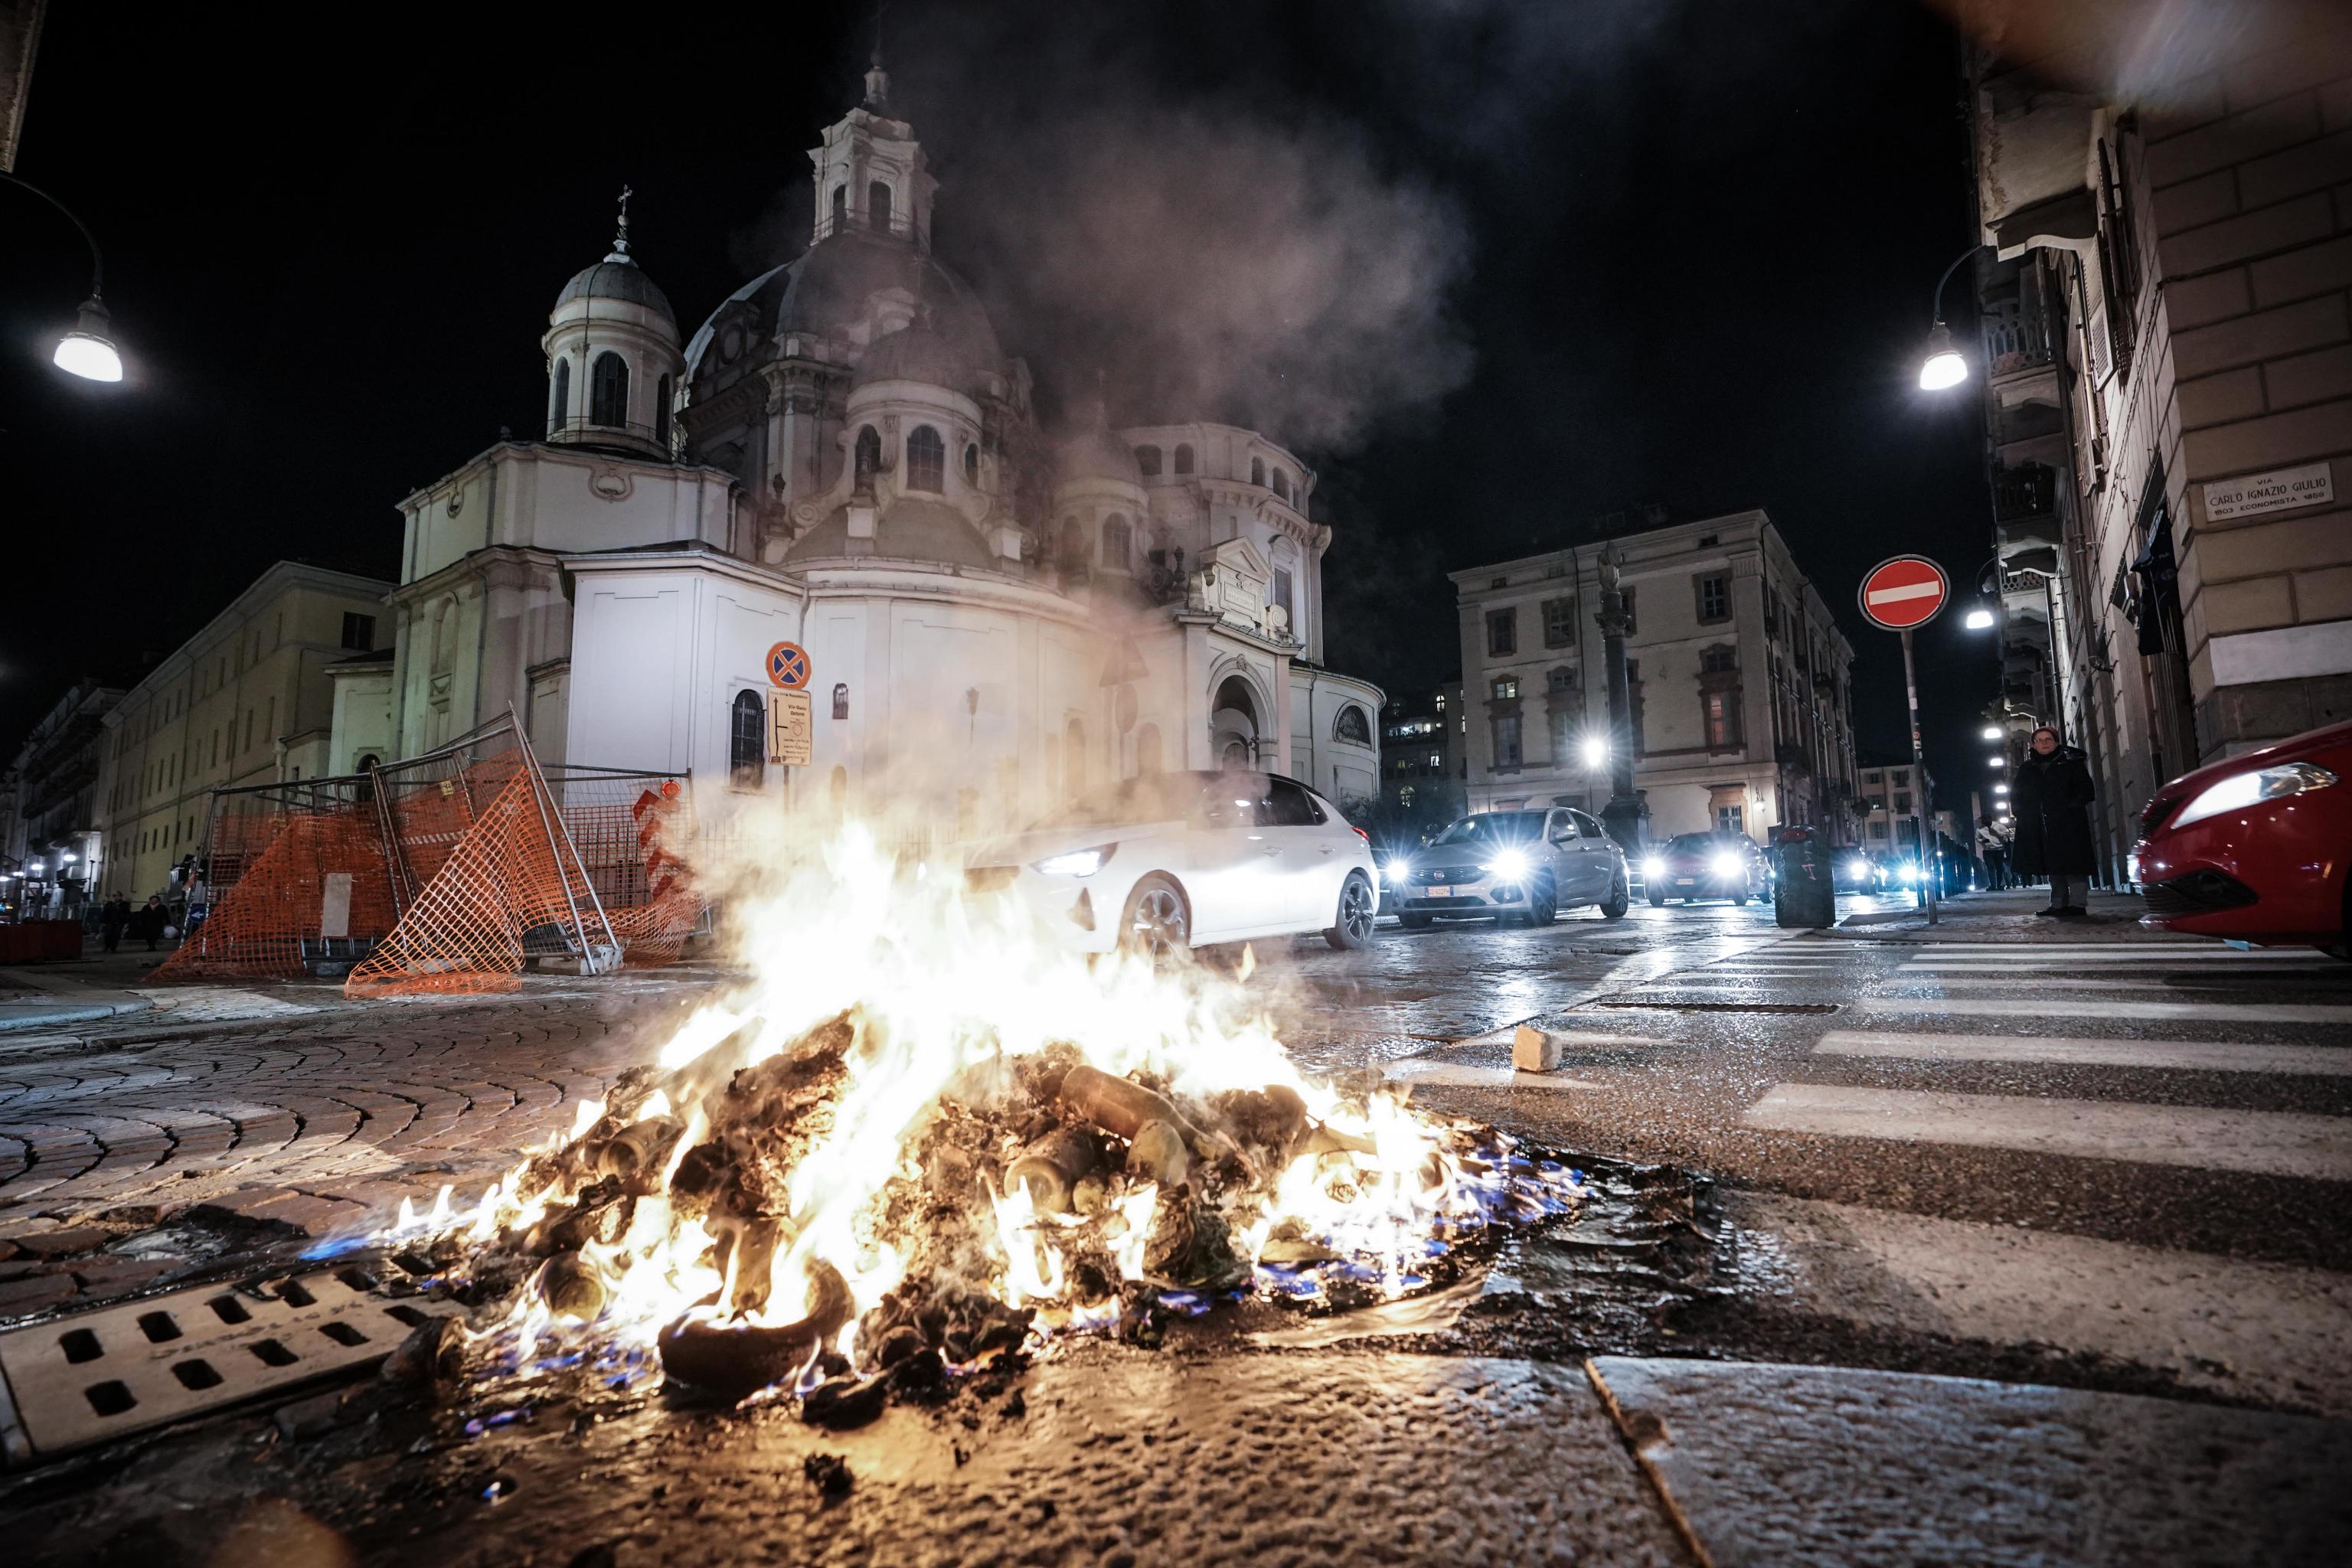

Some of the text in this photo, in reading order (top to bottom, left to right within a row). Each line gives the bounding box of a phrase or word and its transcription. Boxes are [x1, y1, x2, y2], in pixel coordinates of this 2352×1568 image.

[2210, 478, 2326, 507] CARLO IGNAZIO GIULIO
[2240, 497, 2298, 511] ECONOMISTA
